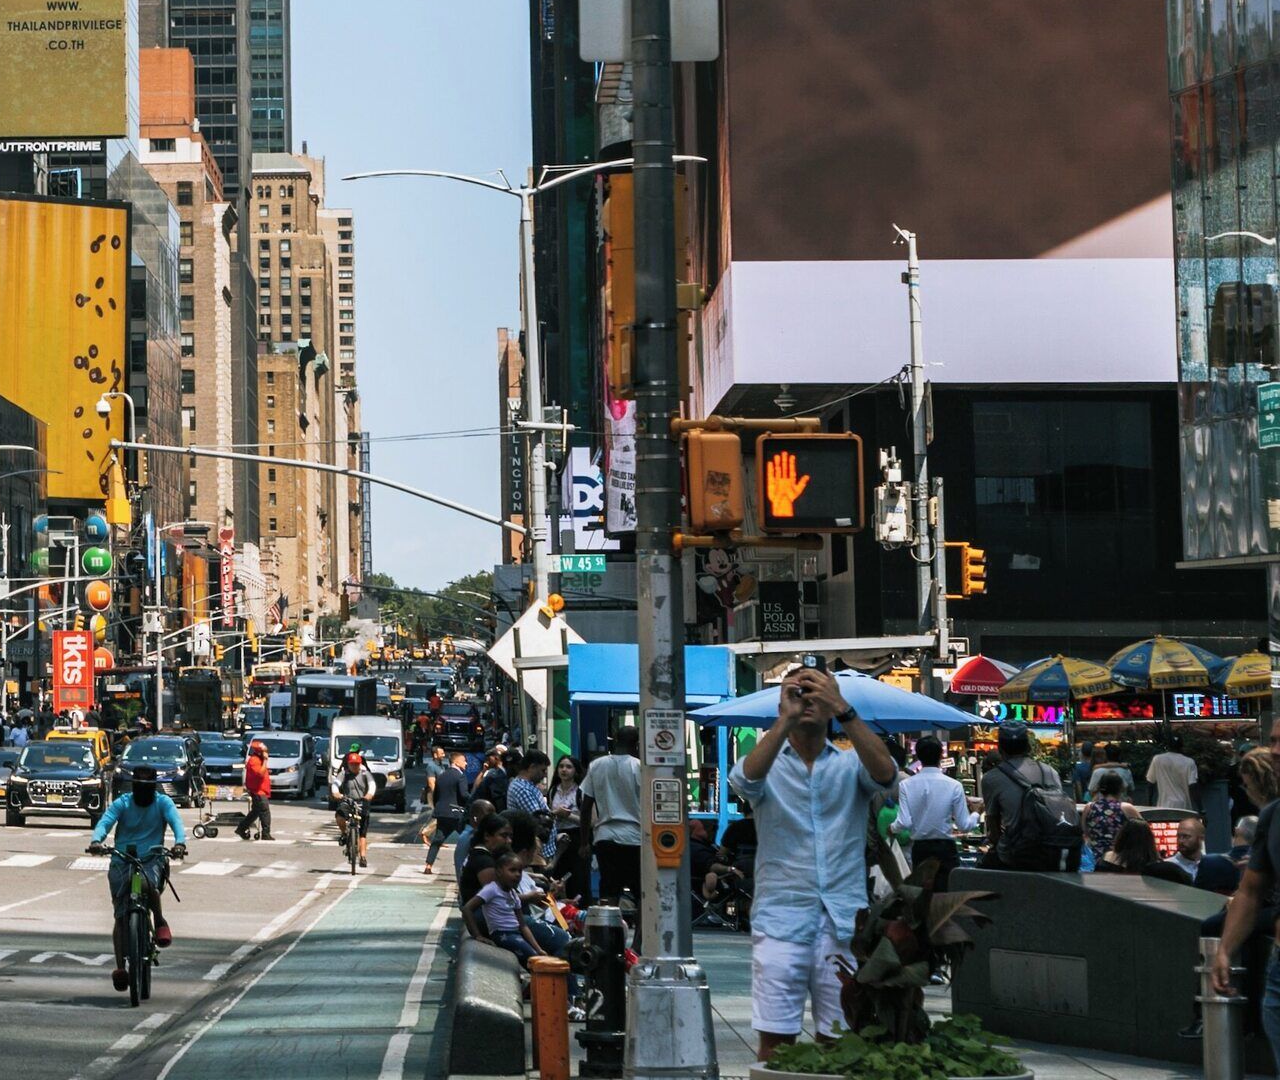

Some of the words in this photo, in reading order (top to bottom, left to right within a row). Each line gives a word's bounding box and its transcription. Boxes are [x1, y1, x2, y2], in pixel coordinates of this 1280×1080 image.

[46, 1, 83, 12] WWW.
[7, 19, 122, 32] THAILANDPRIVILEGE
[44, 39, 85, 51] .CO.TH
[87, 524, 98, 534] m
[90, 555, 104, 567] m
[562, 557, 573, 570] W
[578, 557, 592, 571] 45
[595, 556, 604, 566] St
[97, 589, 108, 601] m
[763, 602, 784, 613] U.S.
[763, 613, 796, 622] POLO
[763, 622, 798, 633] ASSN.
[62, 634, 88, 685] tkts
[960, 683, 975, 693] COLD
